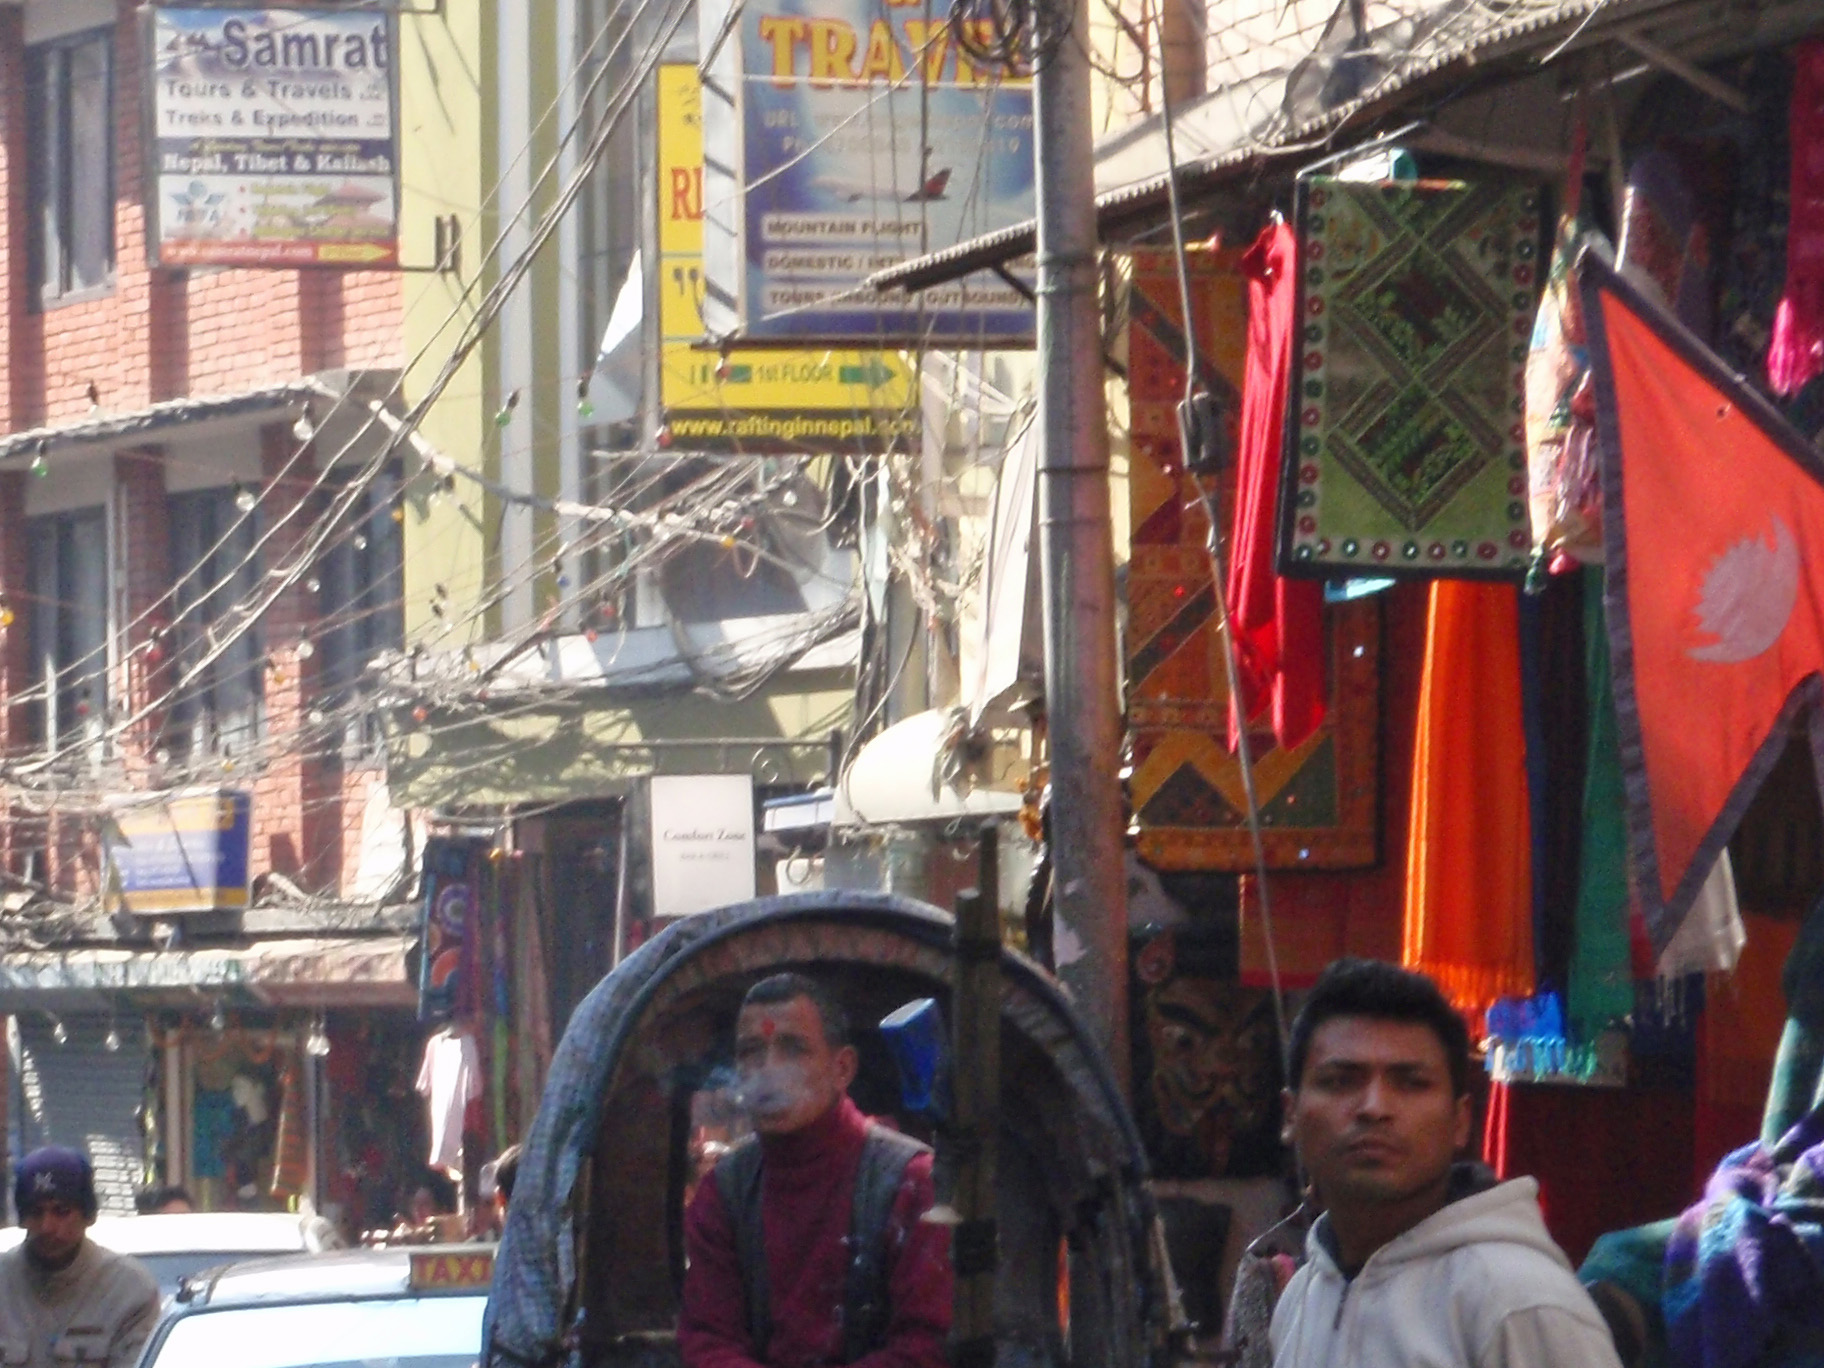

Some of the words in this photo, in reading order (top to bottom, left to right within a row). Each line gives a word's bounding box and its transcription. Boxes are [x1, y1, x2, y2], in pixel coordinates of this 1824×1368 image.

[224, 19, 388, 68] Samrat
[166, 79, 231, 99] Tours
[242, 78, 255, 98] &
[269, 79, 352, 100] Travels
[165, 109, 223, 126] Treks
[253, 109, 358, 128] Expedition
[234, 153, 288, 172] Tibet
[768, 221, 856, 236] MOUNTAIN
[781, 365, 835, 384] FLOOR
[413, 1254, 491, 1284] TAXI
